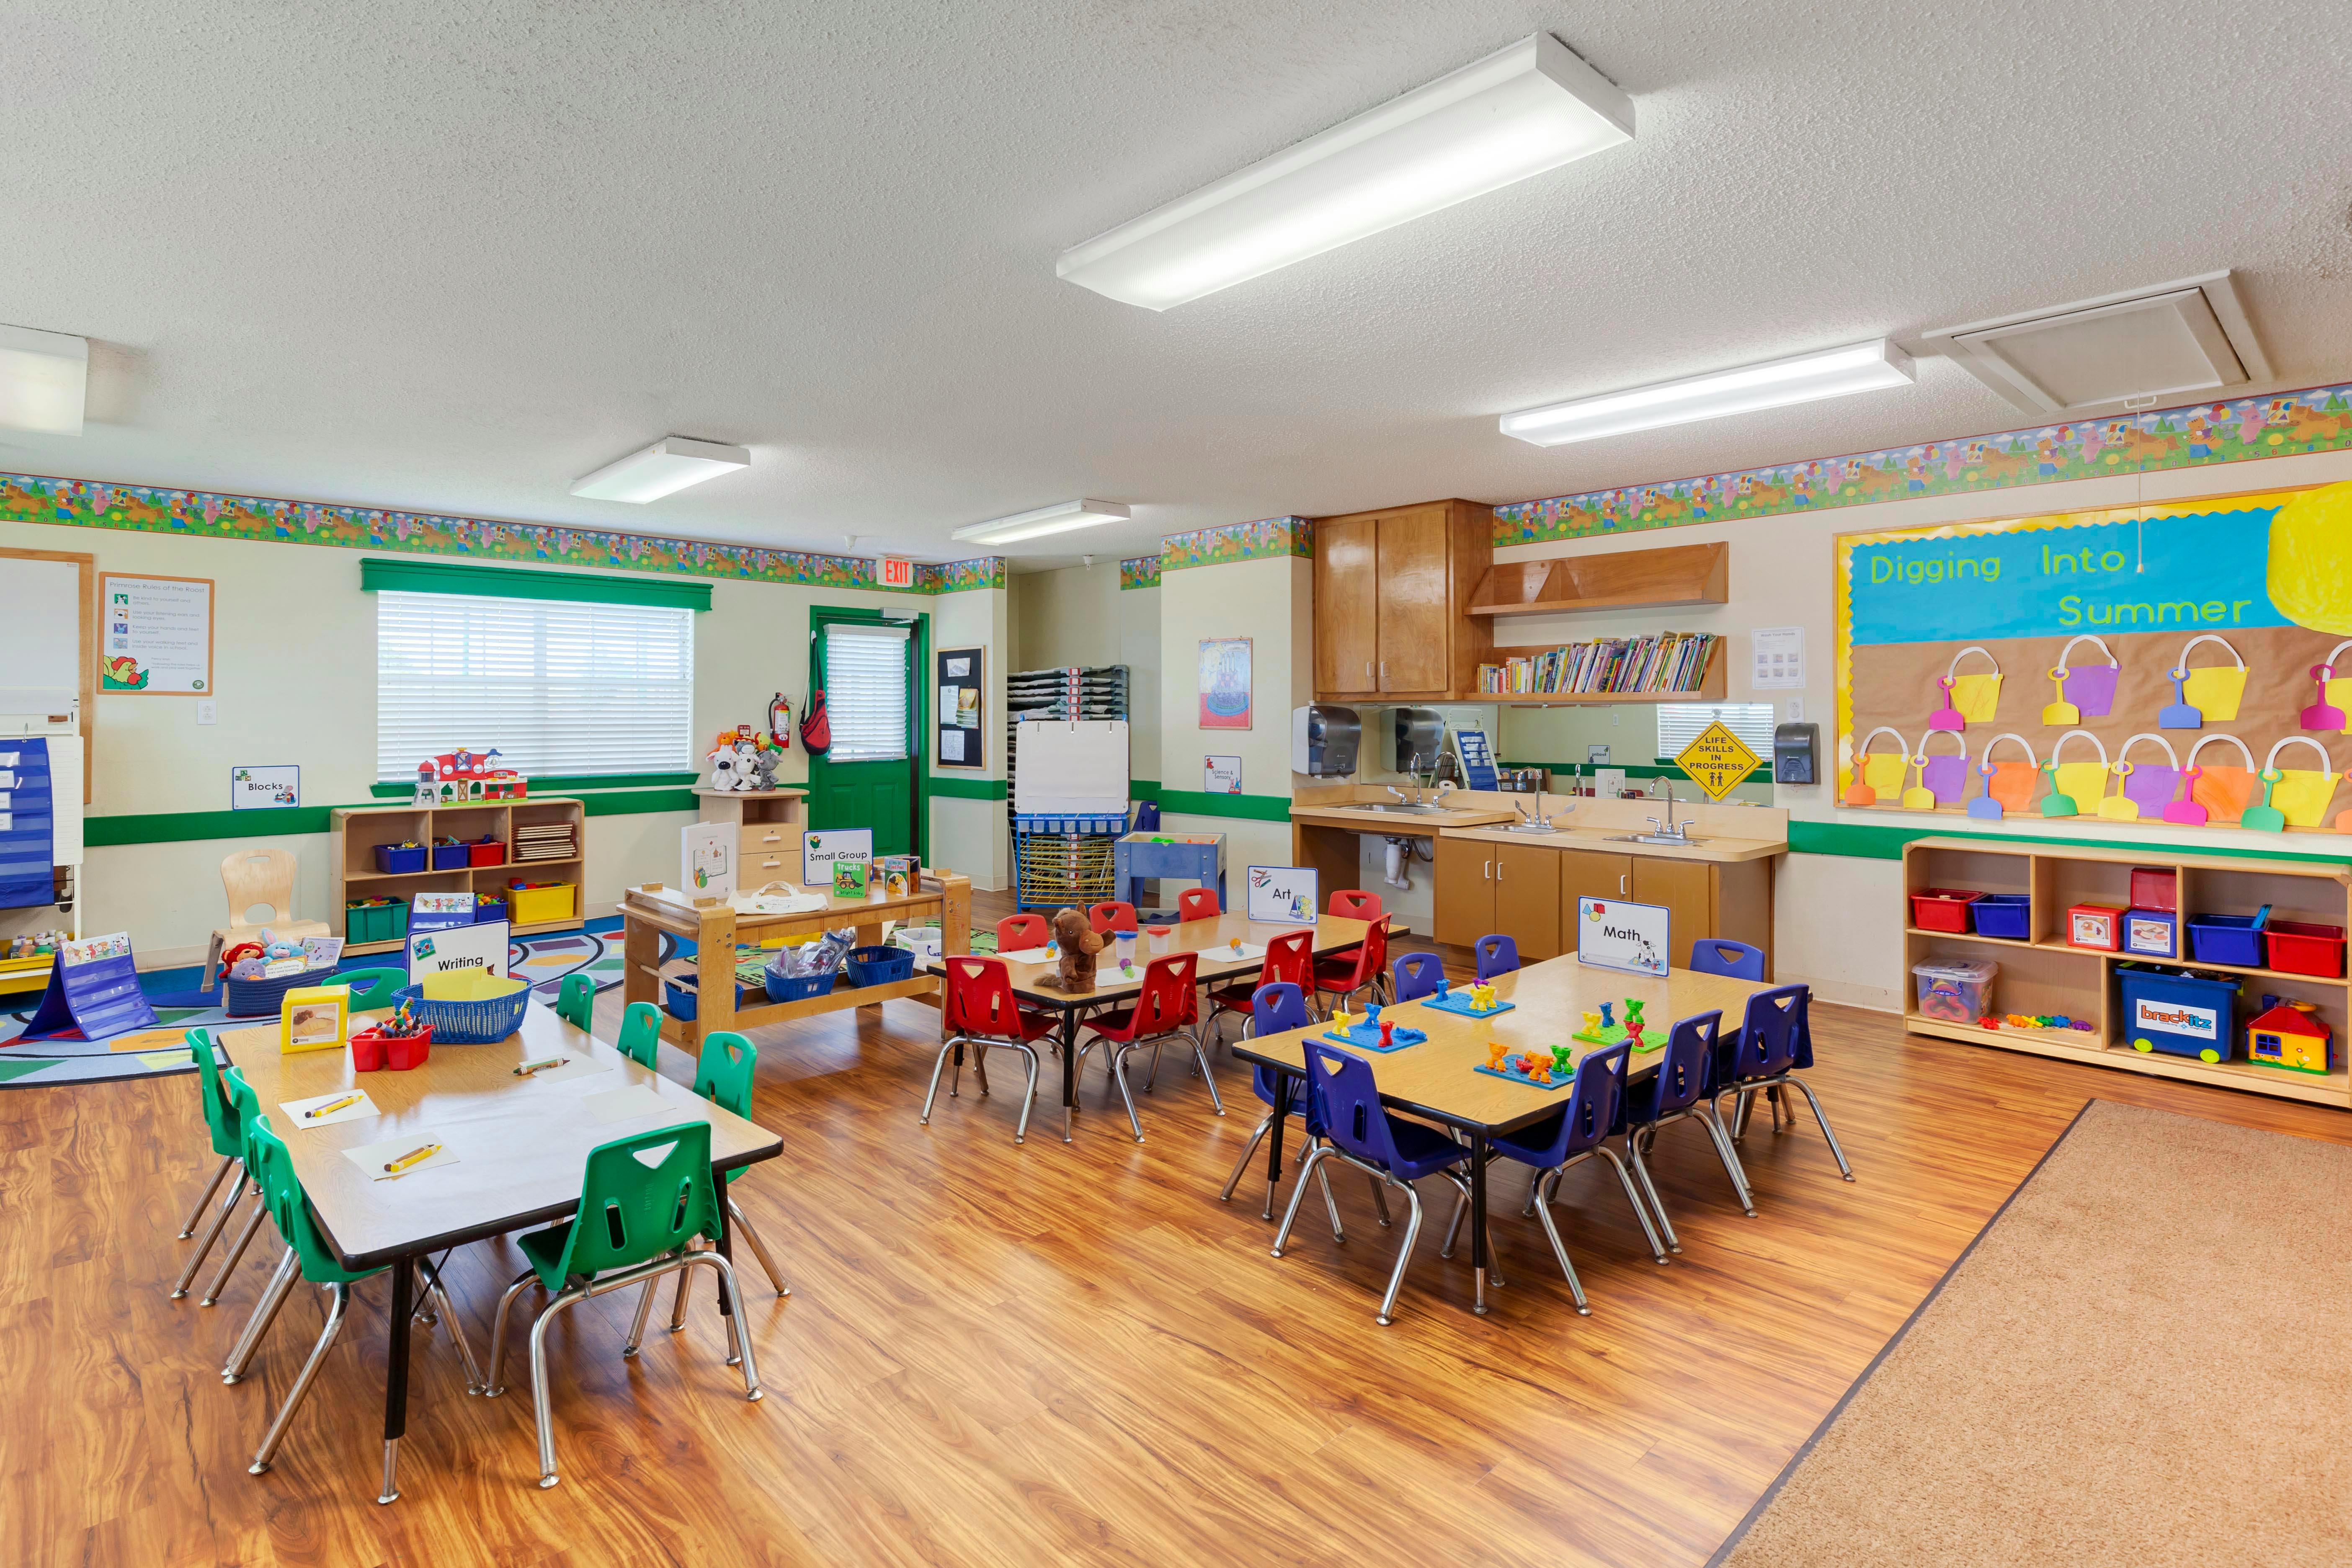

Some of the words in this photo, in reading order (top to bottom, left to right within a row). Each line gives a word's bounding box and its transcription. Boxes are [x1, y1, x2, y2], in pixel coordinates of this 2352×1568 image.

[886, 560, 909, 583] EXIT
[1872, 551, 2000, 584] Digging
[2043, 544, 2125, 574] Into
[2059, 595, 2251, 625] Summer
[810, 852, 835, 861] Small
[1272, 888, 1291, 900] Art
[1604, 926, 1640, 941] Math
[438, 957, 483, 971] Writing
[2141, 1005, 2212, 1029] brackitz
